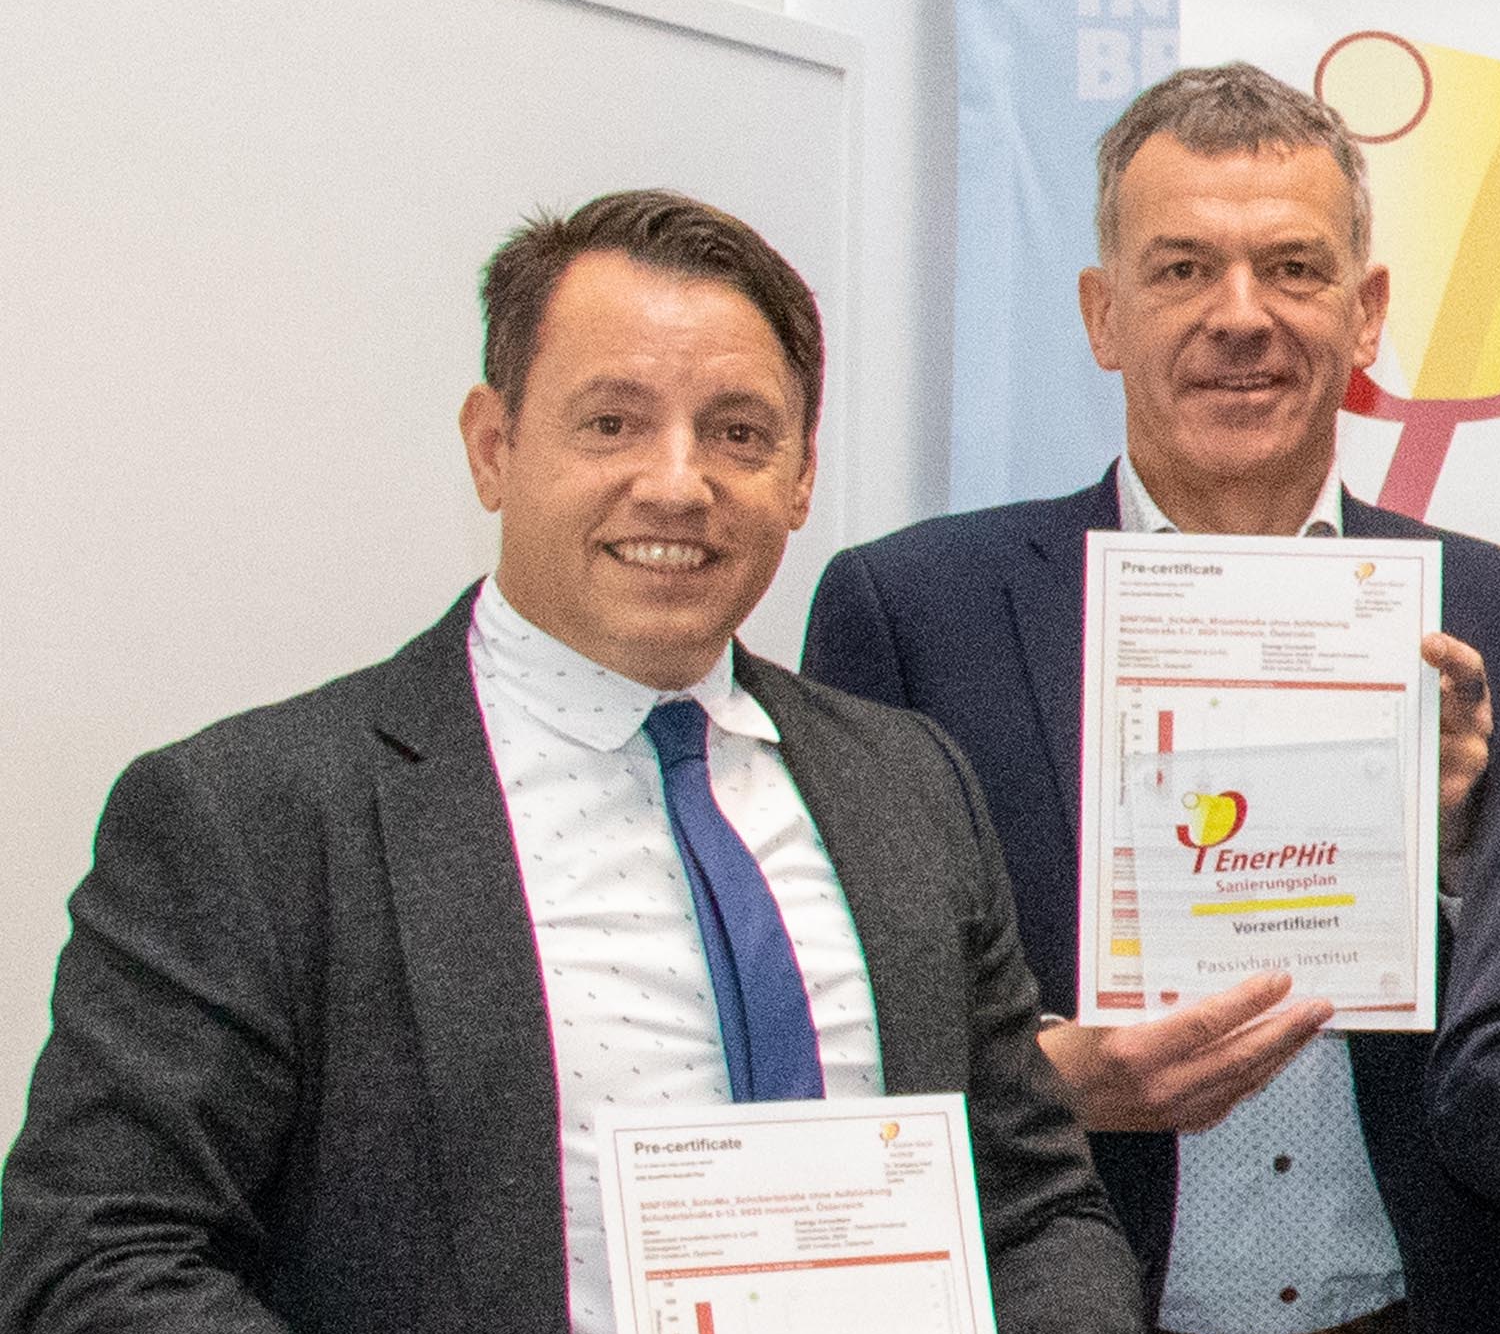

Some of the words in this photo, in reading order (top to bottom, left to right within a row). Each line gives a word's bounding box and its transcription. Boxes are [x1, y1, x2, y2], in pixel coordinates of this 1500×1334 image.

[1121, 561, 1223, 576] Pre-certificate
[1214, 840, 1340, 873] EnerPHit
[1216, 874, 1338, 894] Sanierungsplan
[1232, 916, 1341, 935] Vorzertifiziert
[633, 1137, 744, 1156] Pre-certificate
